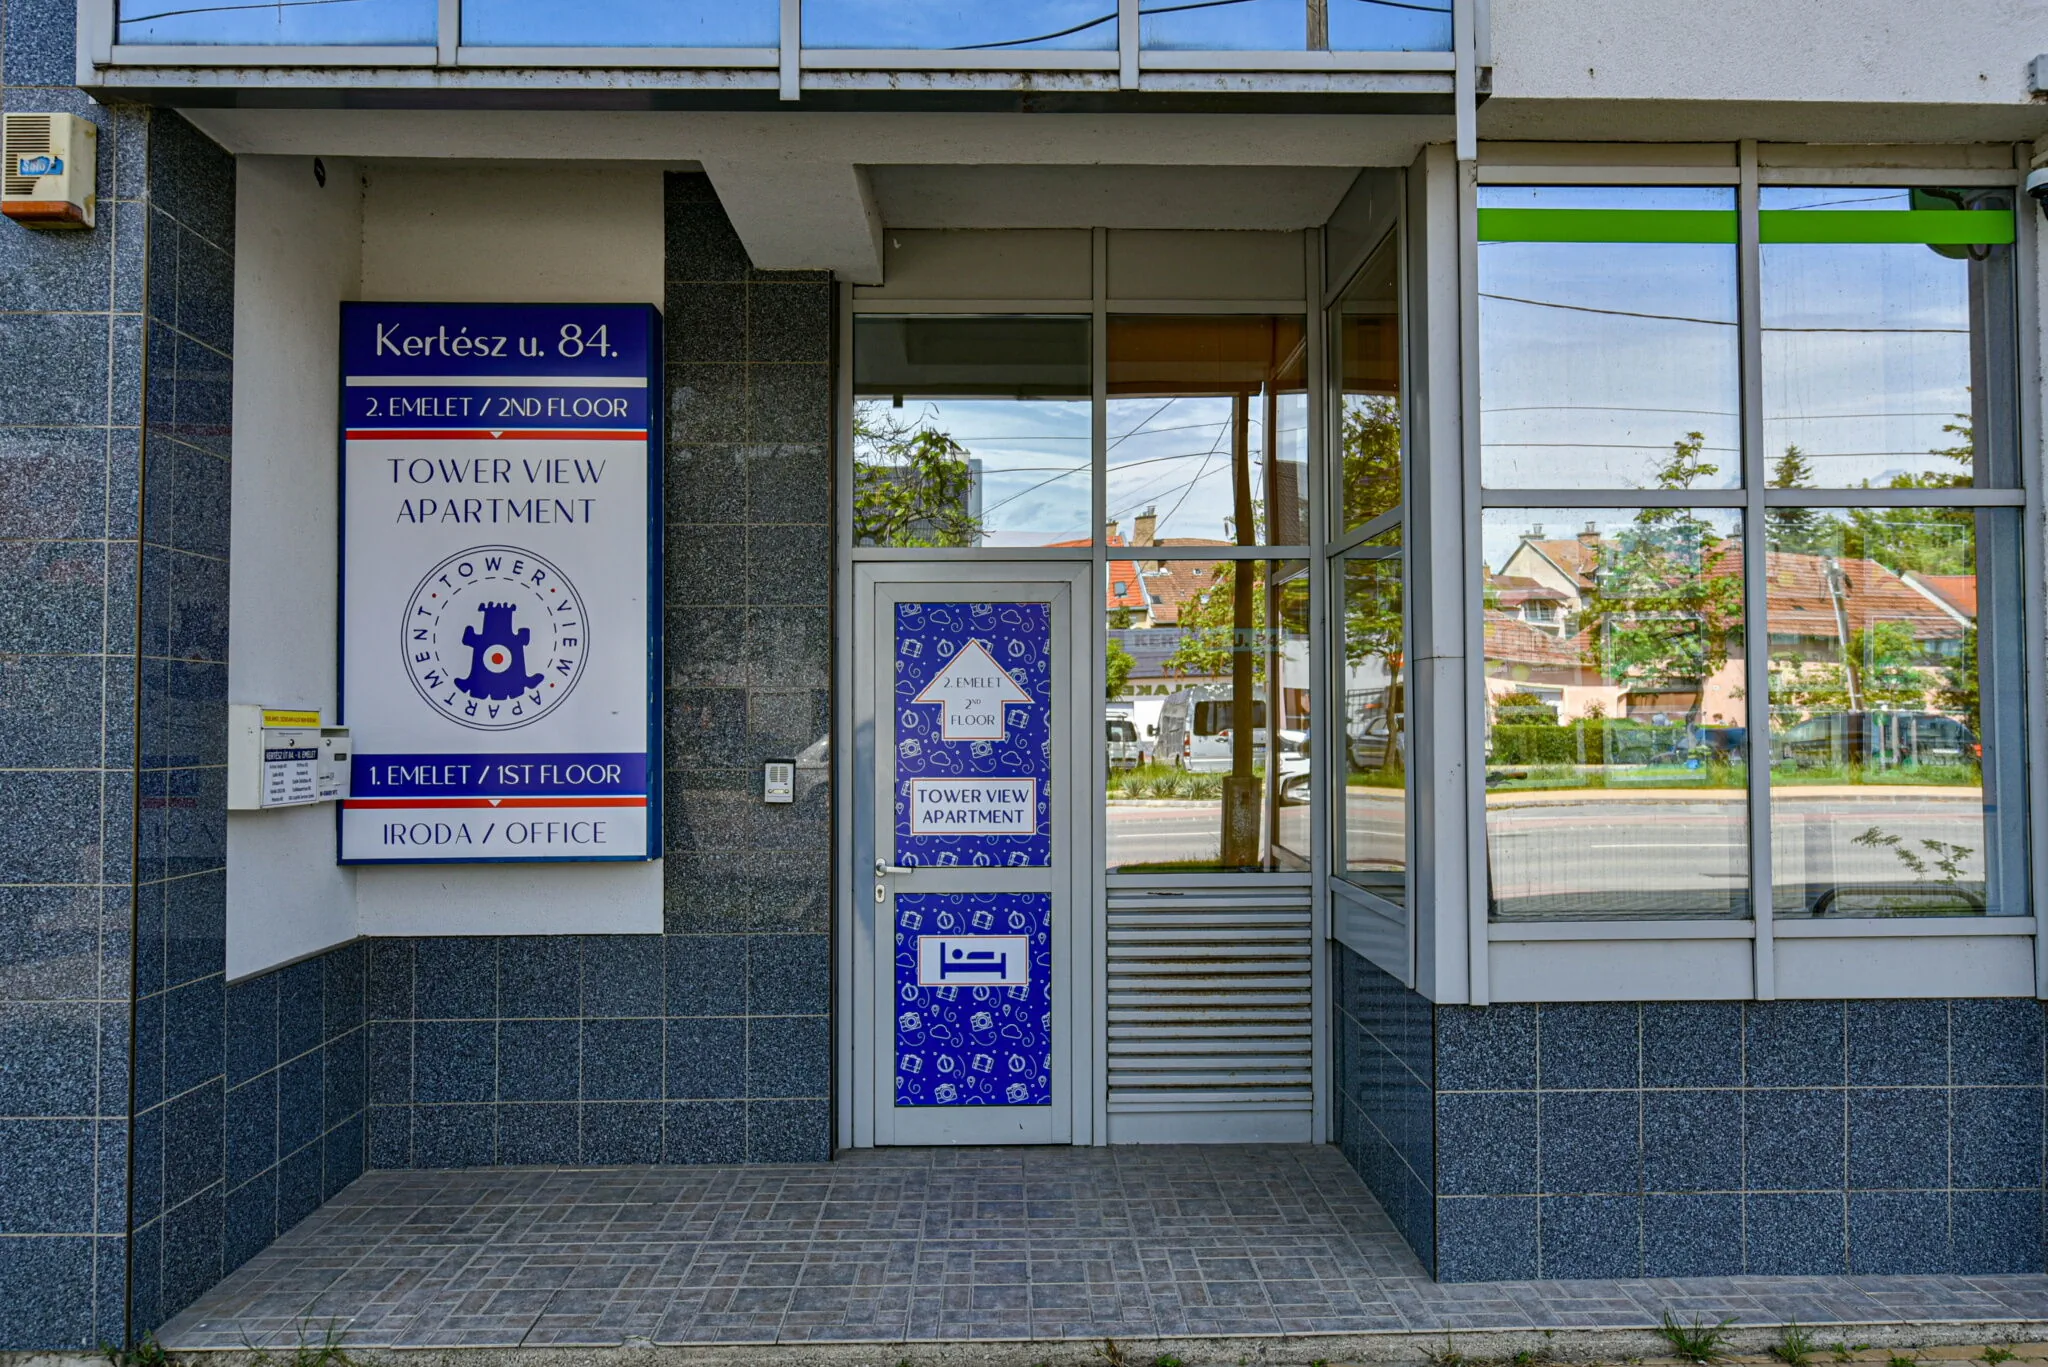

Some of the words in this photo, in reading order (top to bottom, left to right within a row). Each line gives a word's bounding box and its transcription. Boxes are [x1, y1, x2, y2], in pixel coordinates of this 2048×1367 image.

[376, 322, 508, 357] Kertész
[518, 336, 545, 358] u.
[558, 323, 619, 358] 84.
[366, 397, 383, 417] 2.
[389, 397, 473, 417] EMELET
[479, 397, 492, 417] /
[498, 397, 542, 418] 2ND
[547, 397, 628, 418] FLOOR
[387, 458, 512, 484] TOWER
[522, 458, 607, 484] VIEW
[396, 498, 597, 524] APARTMENT
[438, 556, 547, 588] TOWER
[556, 599, 578, 677] VIEW
[413, 605, 543, 720] APARTMENT
[943, 676, 953, 689] 2.
[956, 676, 1003, 689] EMELET
[964, 698, 982, 710] 2ND
[951, 714, 996, 726] FLOOR
[369, 766, 381, 785] 1.
[387, 765, 472, 785] EMELET
[478, 765, 490, 785] /
[497, 764, 535, 785] 1ST
[540, 763, 621, 785] FLOOR
[917, 789, 981, 804] TOWER
[986, 789, 1030, 804] VIEW
[922, 809, 1025, 824] APARTMENT
[383, 822, 473, 845] IRODA
[482, 822, 496, 845] /
[505, 821, 607, 845] OFFICE
